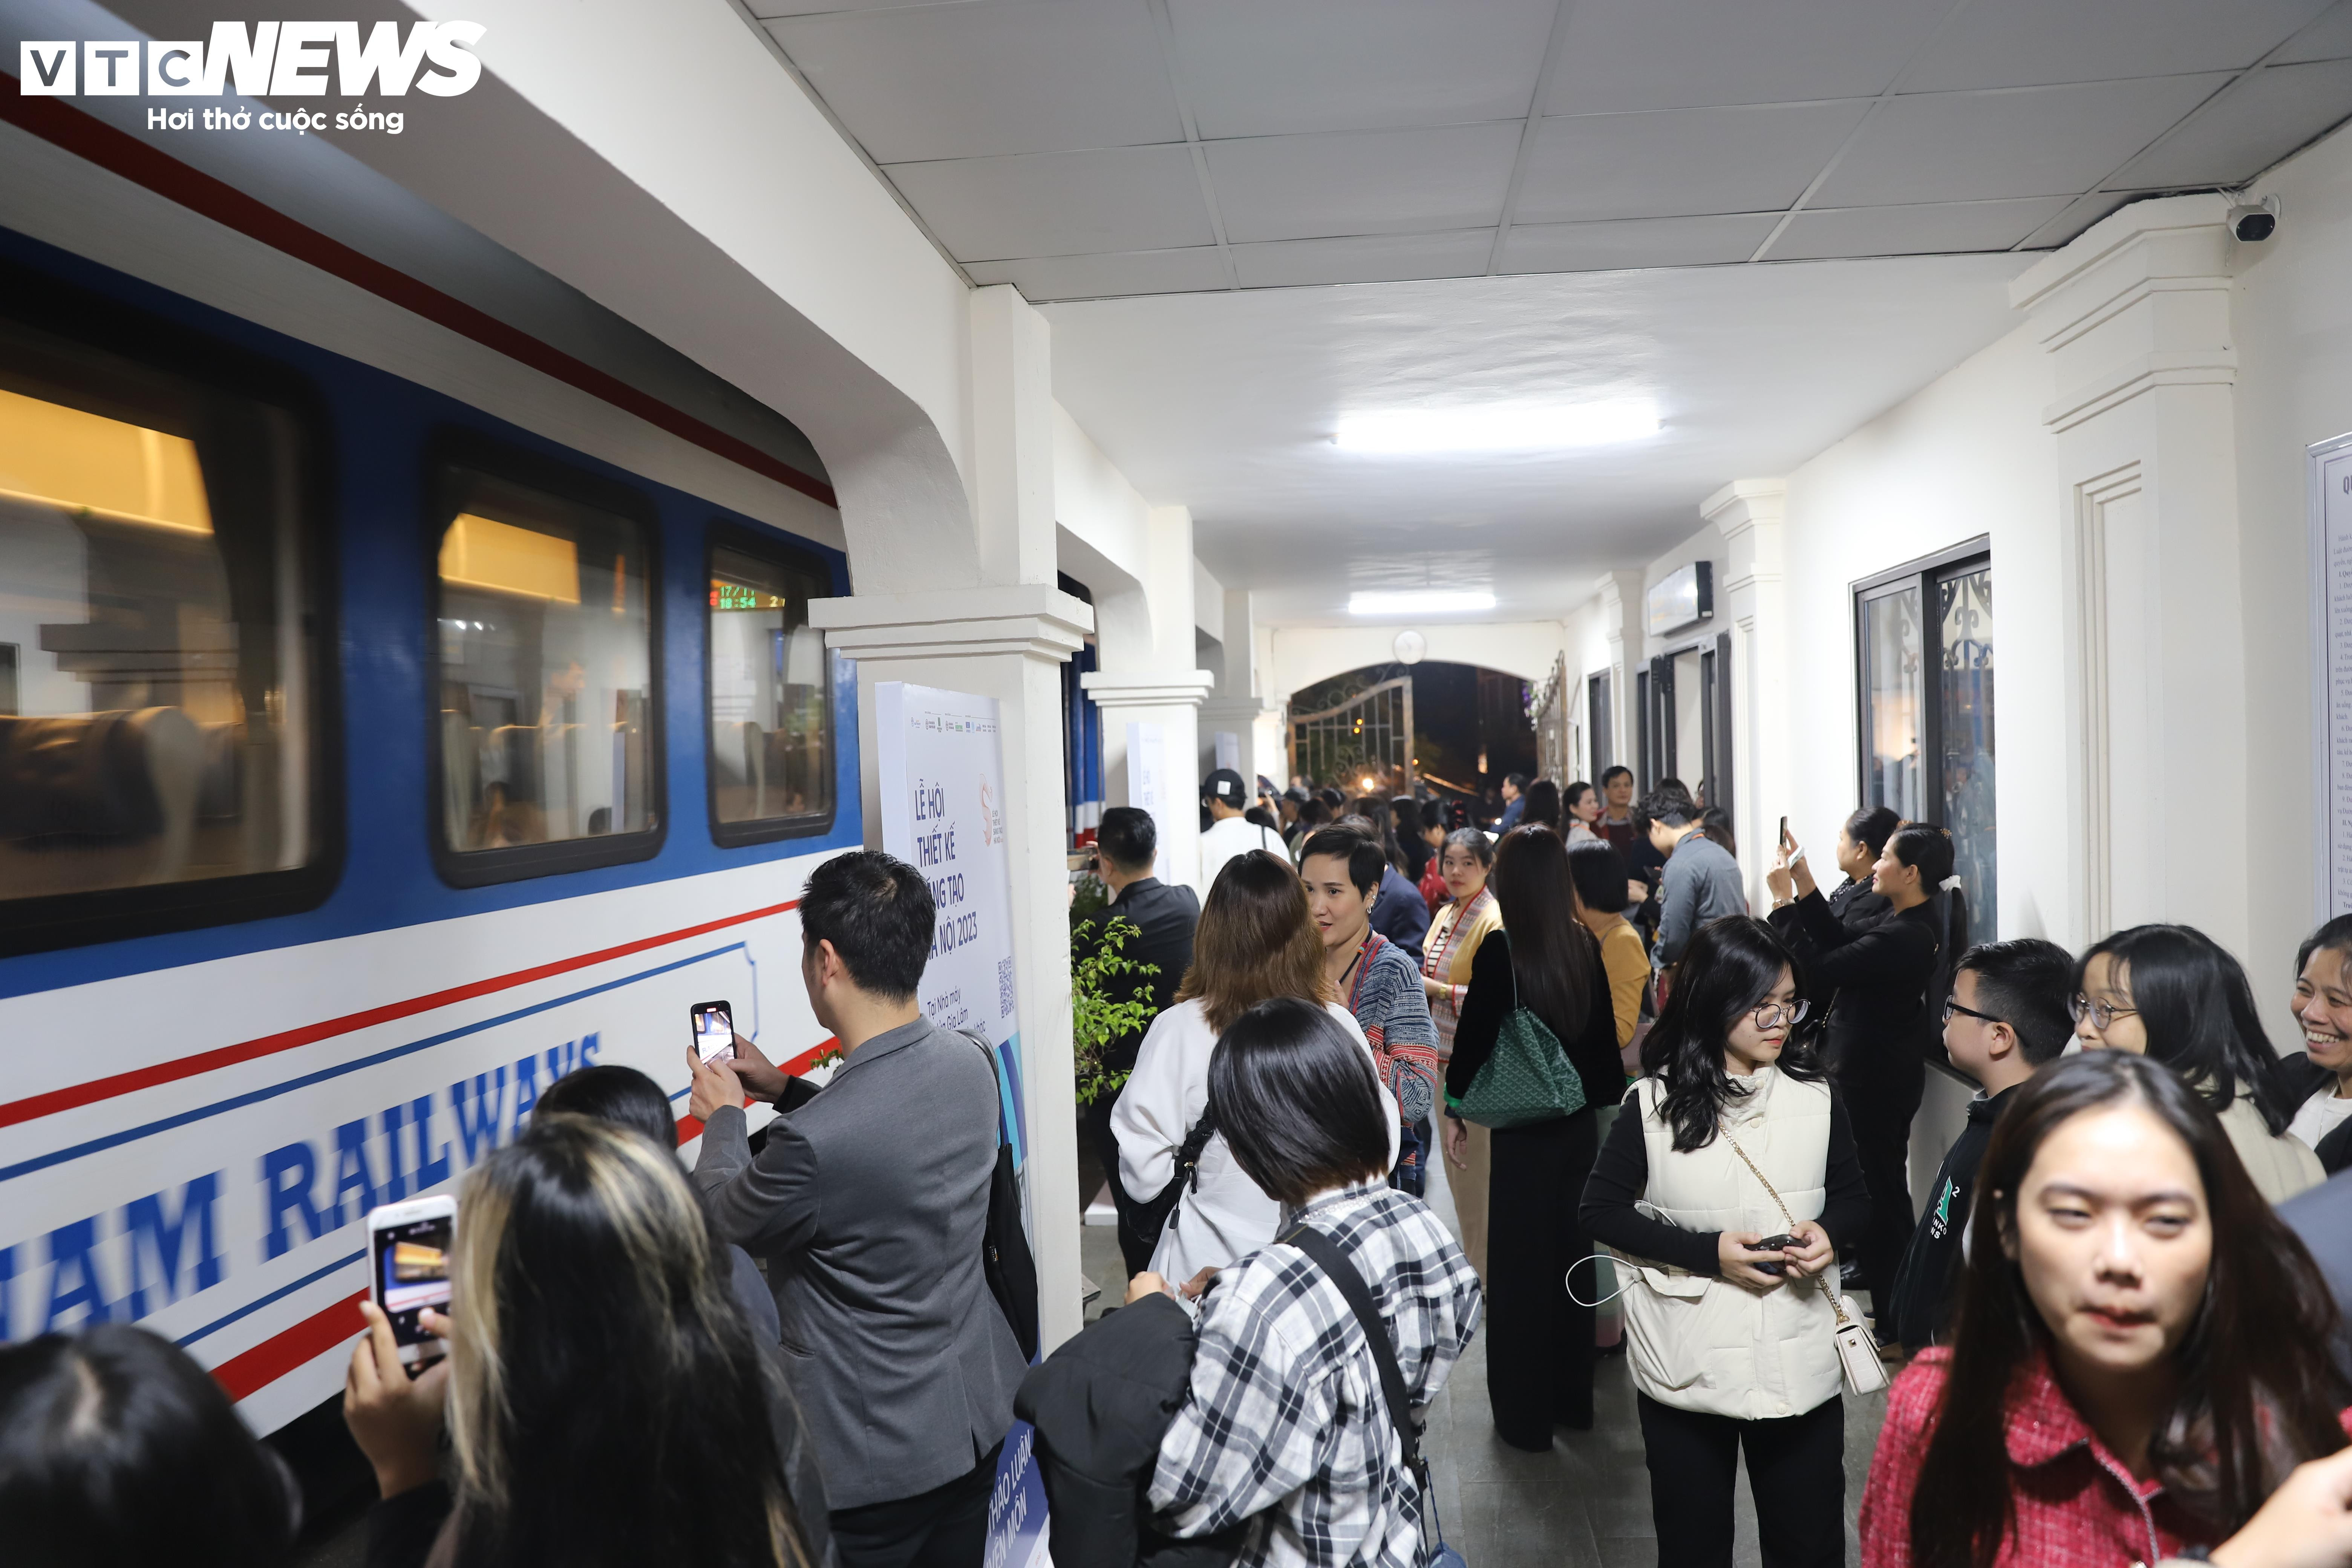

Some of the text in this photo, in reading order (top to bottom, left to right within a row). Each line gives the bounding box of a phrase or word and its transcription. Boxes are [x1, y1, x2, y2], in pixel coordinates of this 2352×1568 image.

[915, 778, 945, 821] LỄ HỘI
[917, 821, 956, 868] THIẾT KẾ
[947, 873, 964, 907] TẠO
[939, 916, 956, 954] NỘI
[957, 911, 977, 946] 2023
[927, 985, 960, 1020] Tại Nhà máy
[947, 1014, 956, 1030] Gia
[957, 1007, 968, 1025] Lâm
[1011, 1429, 1031, 1491] LUẬN
[1007, 1487, 1027, 1550] MÔN
